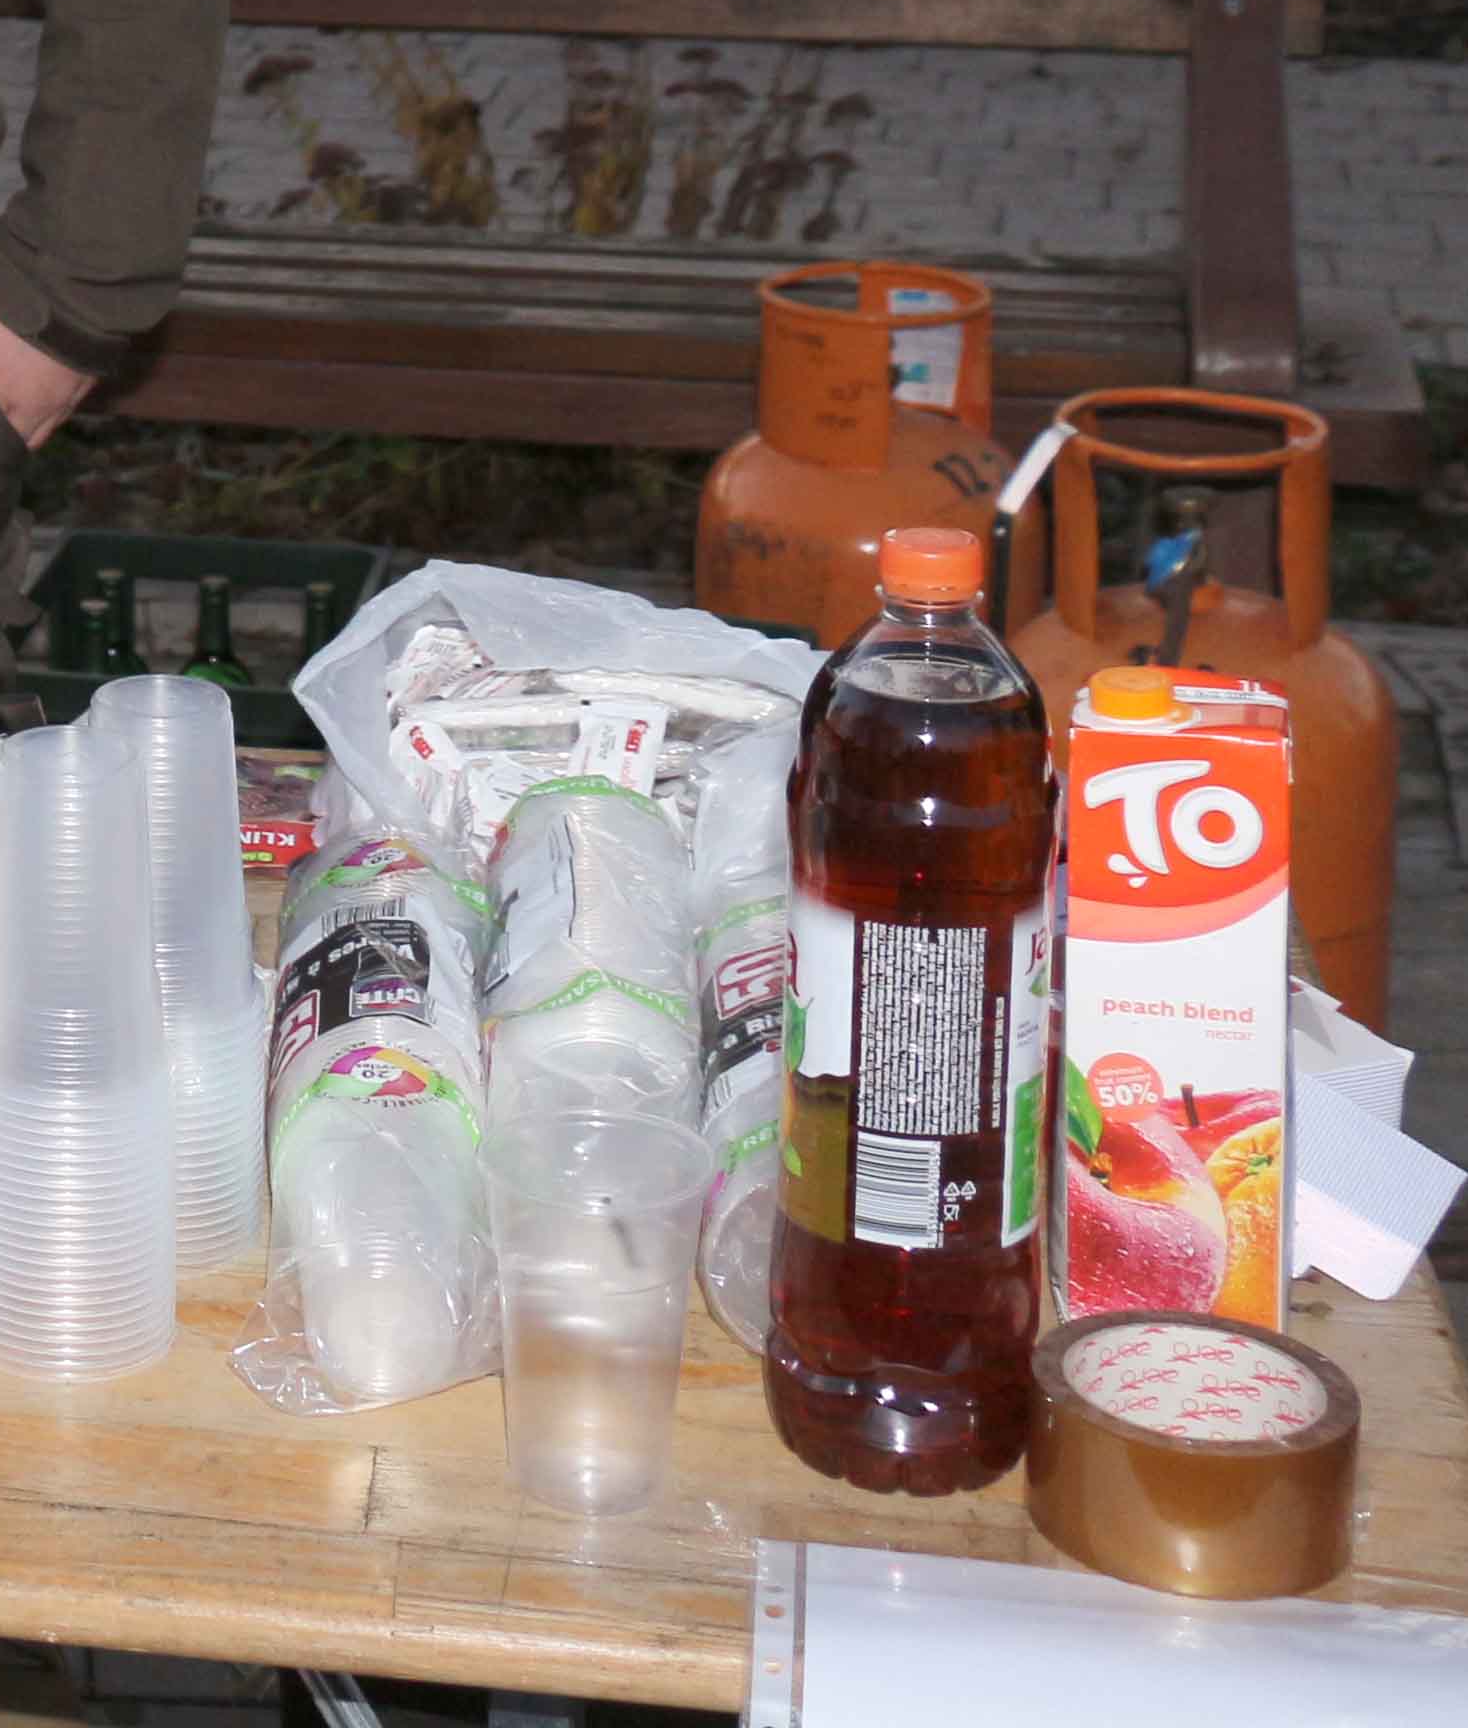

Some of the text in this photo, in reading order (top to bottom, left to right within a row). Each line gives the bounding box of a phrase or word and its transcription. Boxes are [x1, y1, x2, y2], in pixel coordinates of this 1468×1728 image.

[1102, 998, 1254, 1023] peach blend
[1205, 1029, 1254, 1041] nectar
[1098, 1082, 1160, 1108] 50%
